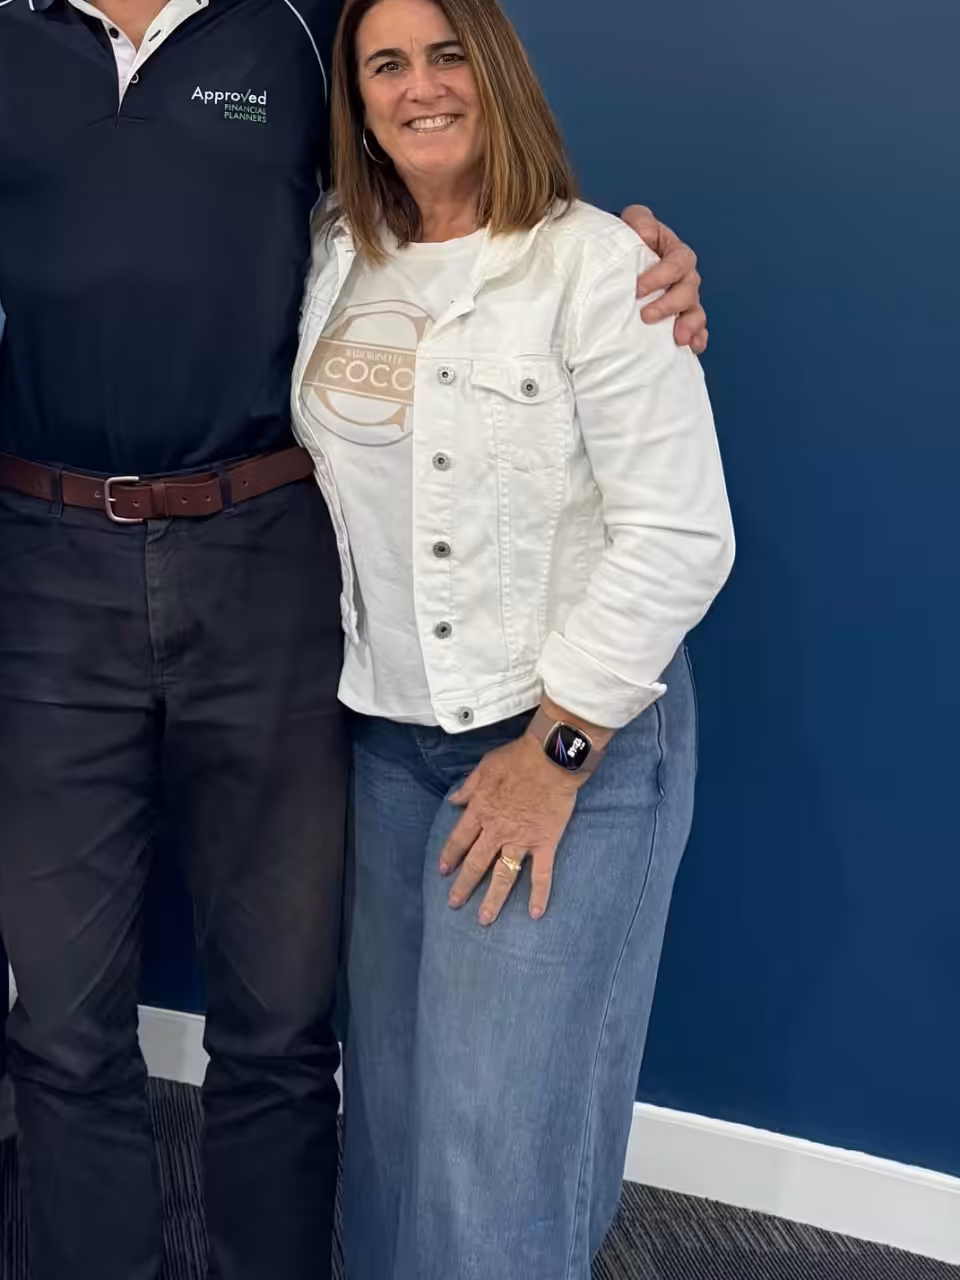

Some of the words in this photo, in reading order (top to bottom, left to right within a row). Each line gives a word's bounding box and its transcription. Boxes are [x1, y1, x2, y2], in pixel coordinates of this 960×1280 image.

[191, 86, 267, 105] Approved
[224, 103, 266, 116] FINANCIAL
[224, 111, 267, 124] PLANNERS
[324, 356, 414, 392] COCO
